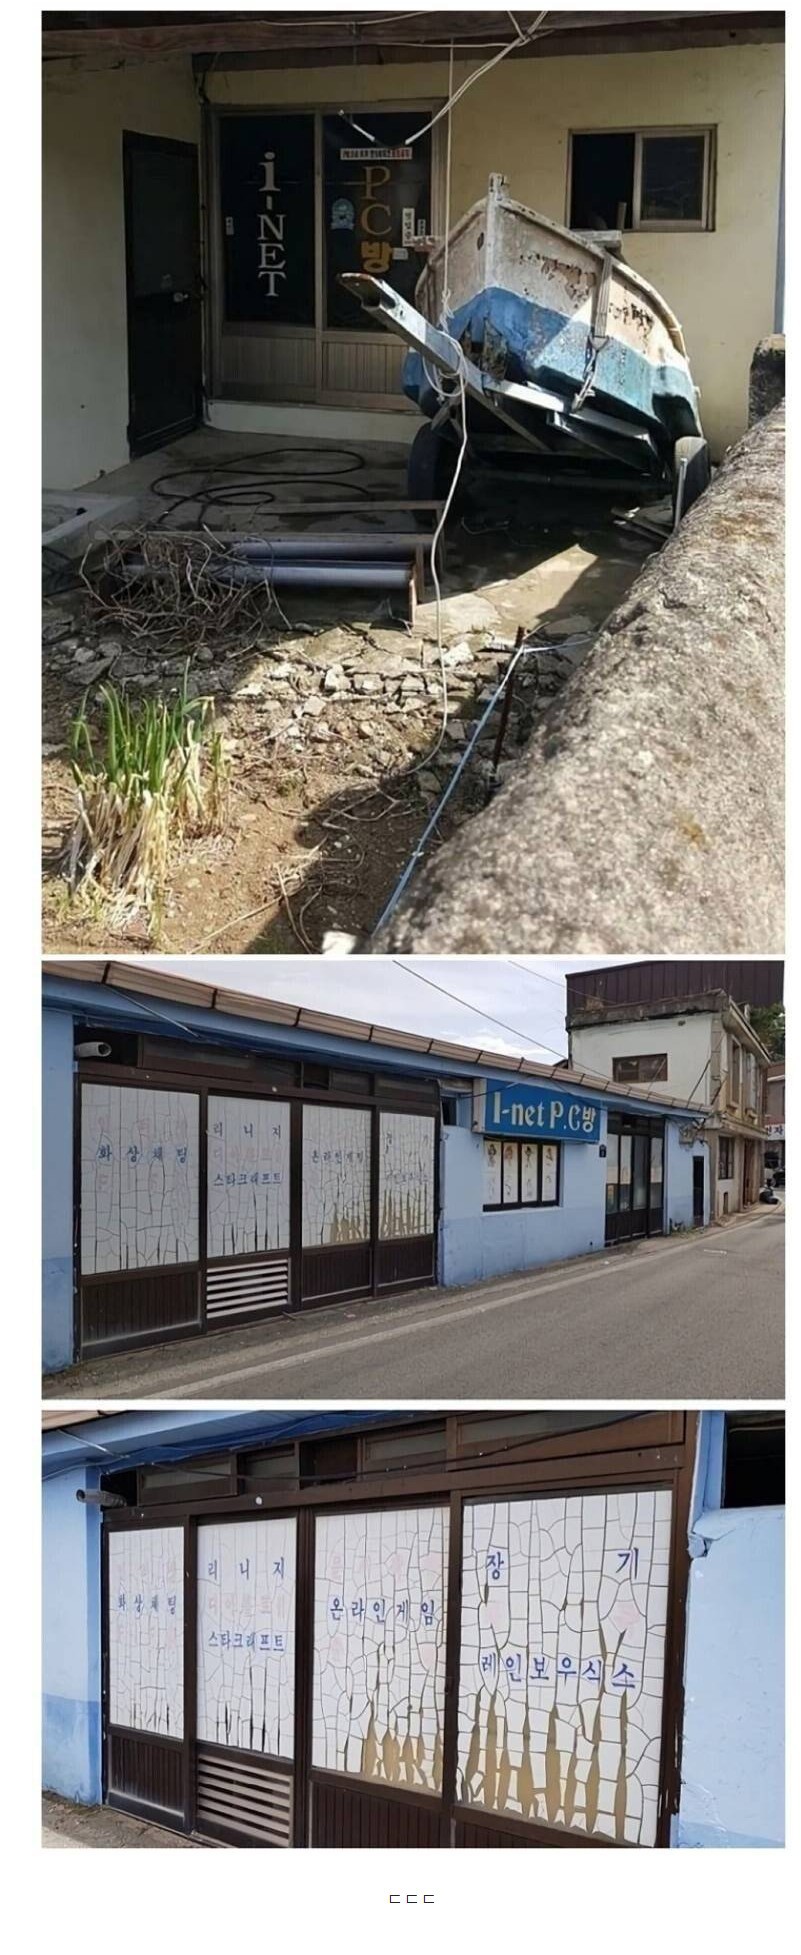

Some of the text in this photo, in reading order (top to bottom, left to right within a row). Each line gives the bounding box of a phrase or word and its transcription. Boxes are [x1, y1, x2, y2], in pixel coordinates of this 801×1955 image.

[257, 152, 287, 297] i-NET
[494, 1091, 544, 1127] I-net
[213, 1122, 281, 1139] 리니지
[208, 1556, 285, 1581] 리니지
[486, 1548, 639, 1580] 장기
[330, 1597, 435, 1626] 온라인게임
[208, 1629, 285, 1651] 스타크래프트
